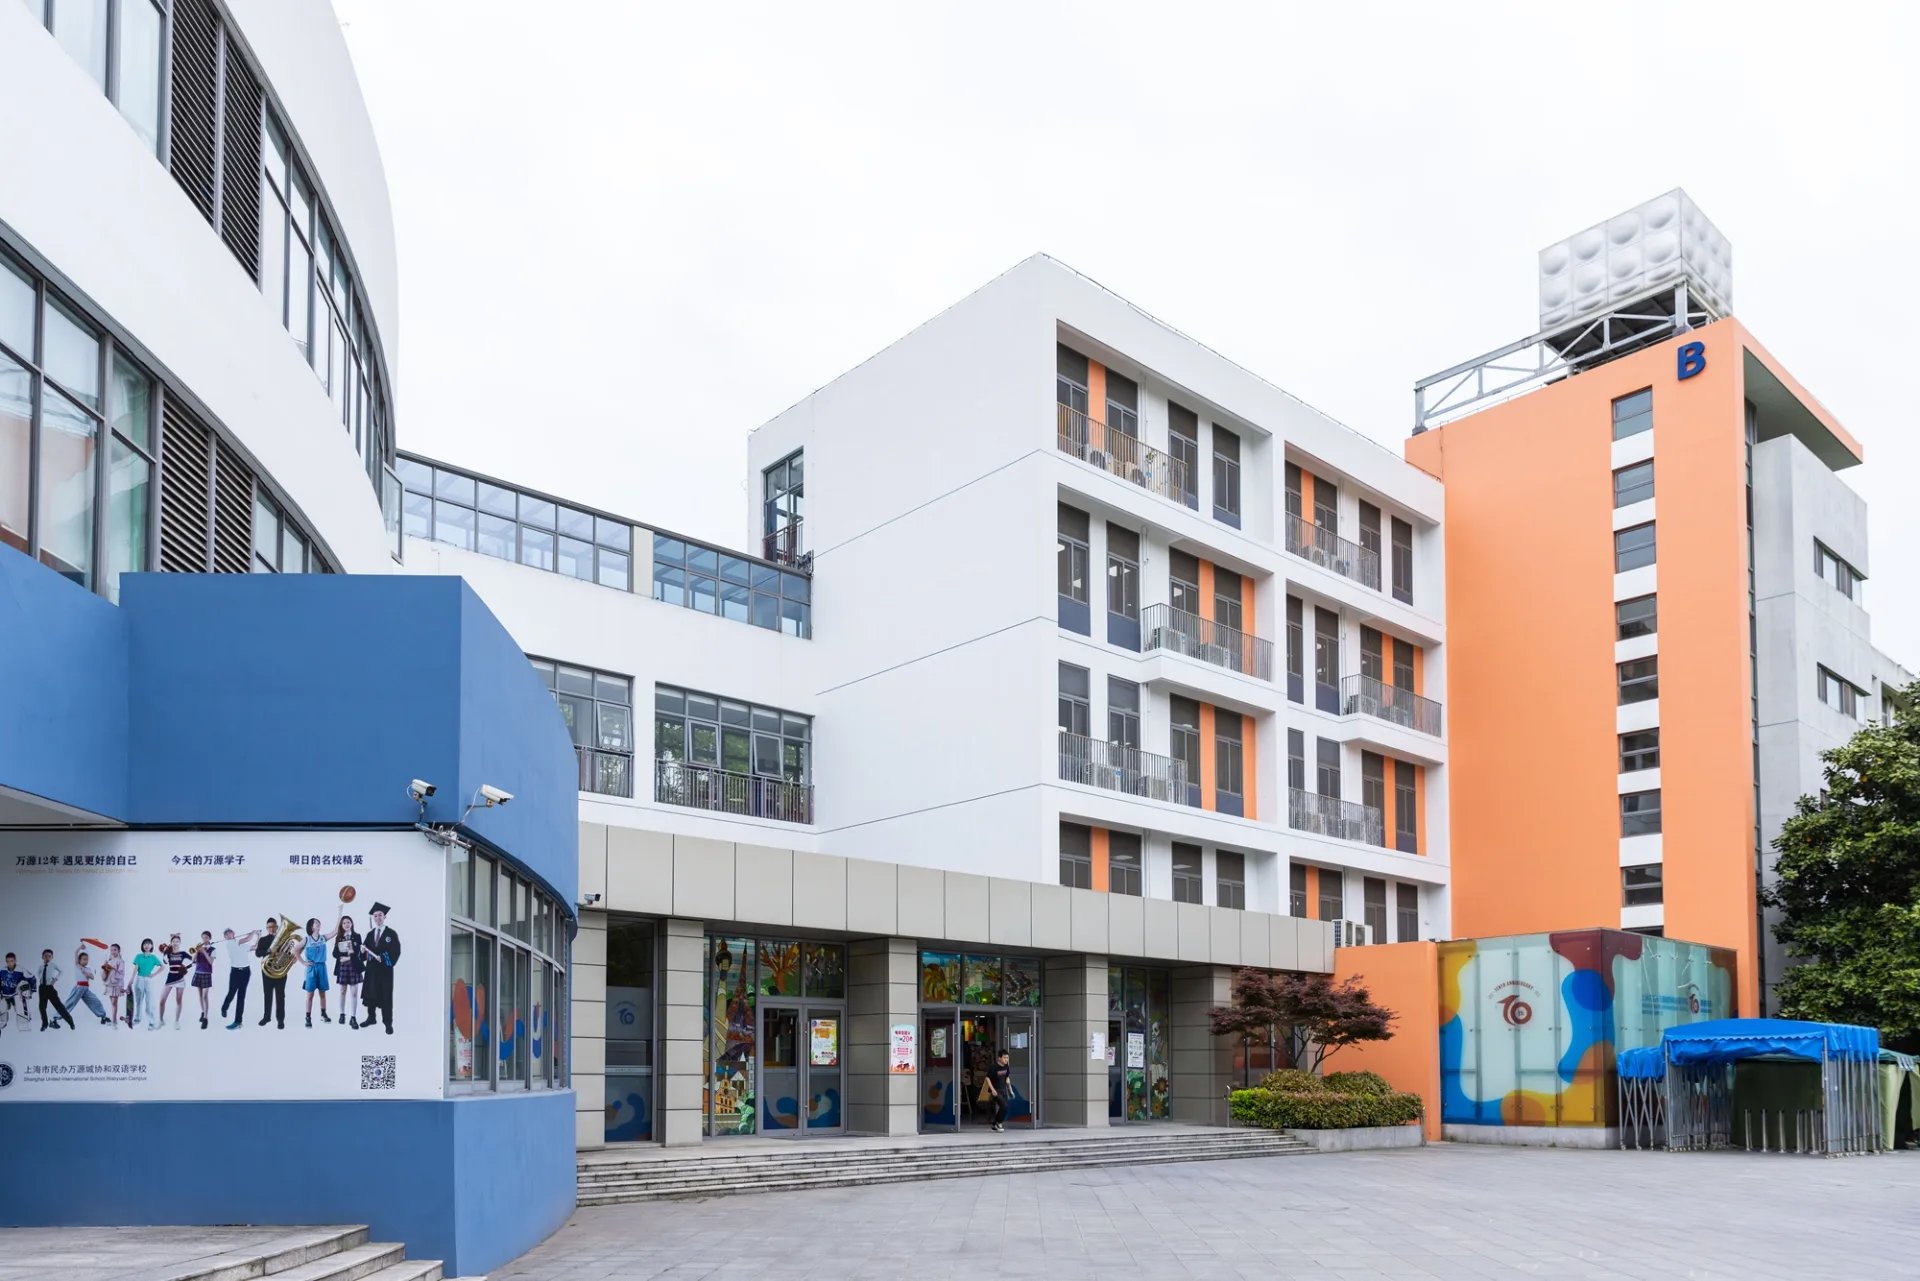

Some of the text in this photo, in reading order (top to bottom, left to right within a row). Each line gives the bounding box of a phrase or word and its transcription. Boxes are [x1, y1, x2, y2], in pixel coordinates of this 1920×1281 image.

[1678, 341, 1706, 381] B
[16, 854, 138, 866] 万源12年 遇见更好的自己
[171, 854, 246, 866] 今天的万源学子
[289, 854, 364, 866] 明日的名校精英
[24, 1064, 147, 1074] 上海市民办万源城协和双语学校
